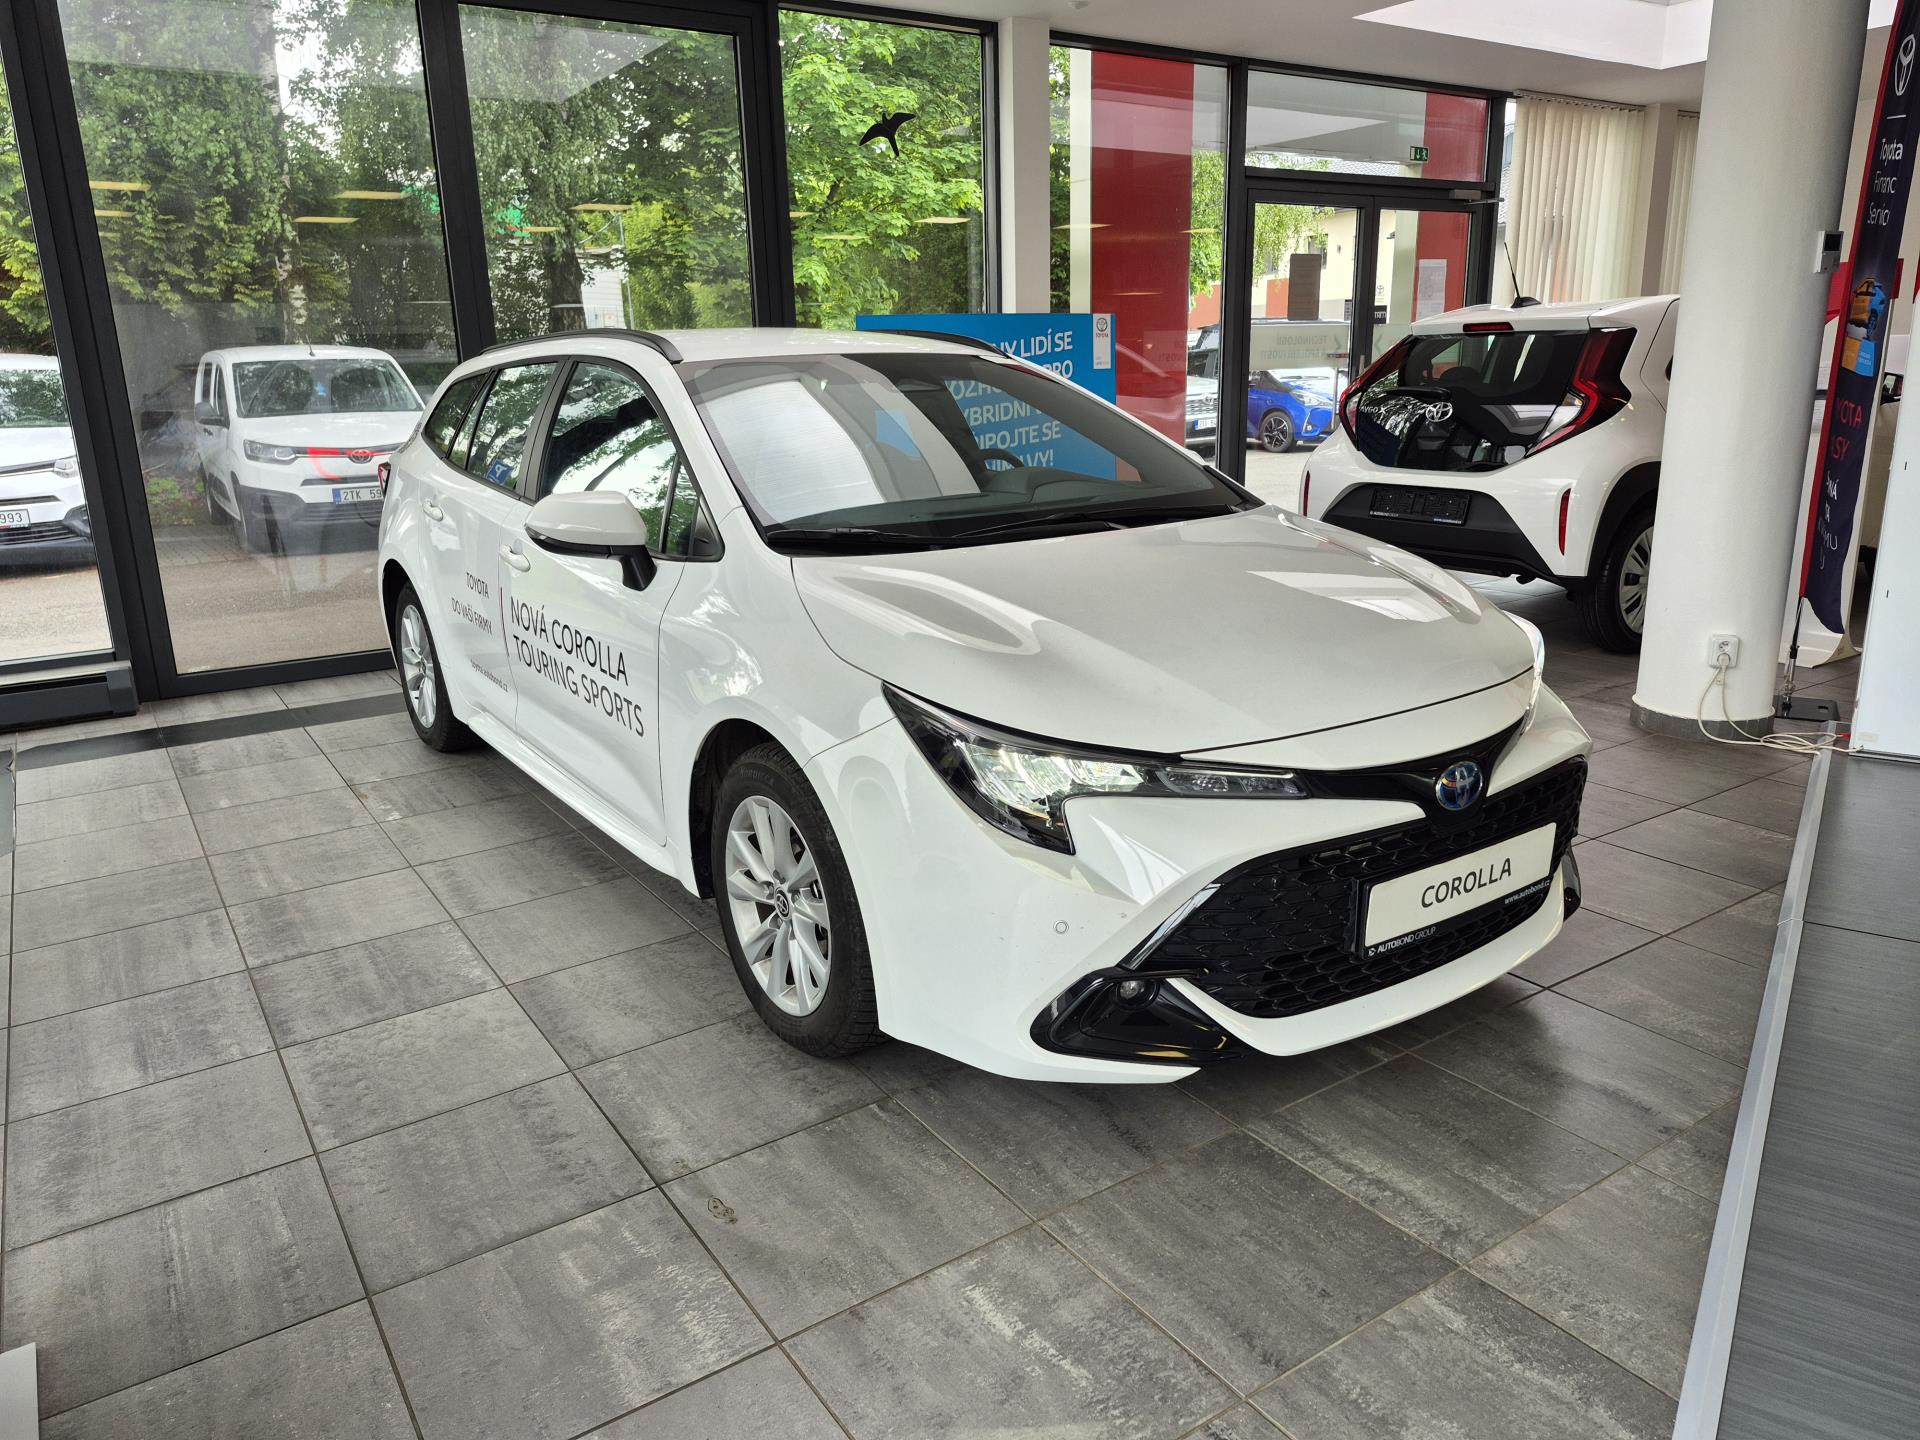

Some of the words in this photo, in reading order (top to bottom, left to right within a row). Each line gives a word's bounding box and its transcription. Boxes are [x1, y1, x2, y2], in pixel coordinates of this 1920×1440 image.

[1879, 138, 1904, 166] Toyota
[1020, 328, 1052, 358] LIDÍ
[1054, 331, 1073, 353] SE
[972, 424, 1040, 450] IPOJTE
[1042, 420, 1062, 441] SE
[343, 490, 361, 501] 2TK
[466, 571, 490, 600] TOYOTA
[451, 597, 461, 615] DO
[510, 596, 549, 643] NOVÁ
[551, 618, 629, 687] COROLLA
[512, 633, 580, 698] TOURING
[580, 673, 645, 738] SPORTS
[1420, 857, 1512, 909] COROLLA
[1376, 933, 1415, 954] AUTOBOND
[1414, 926, 1436, 940] GROUP
